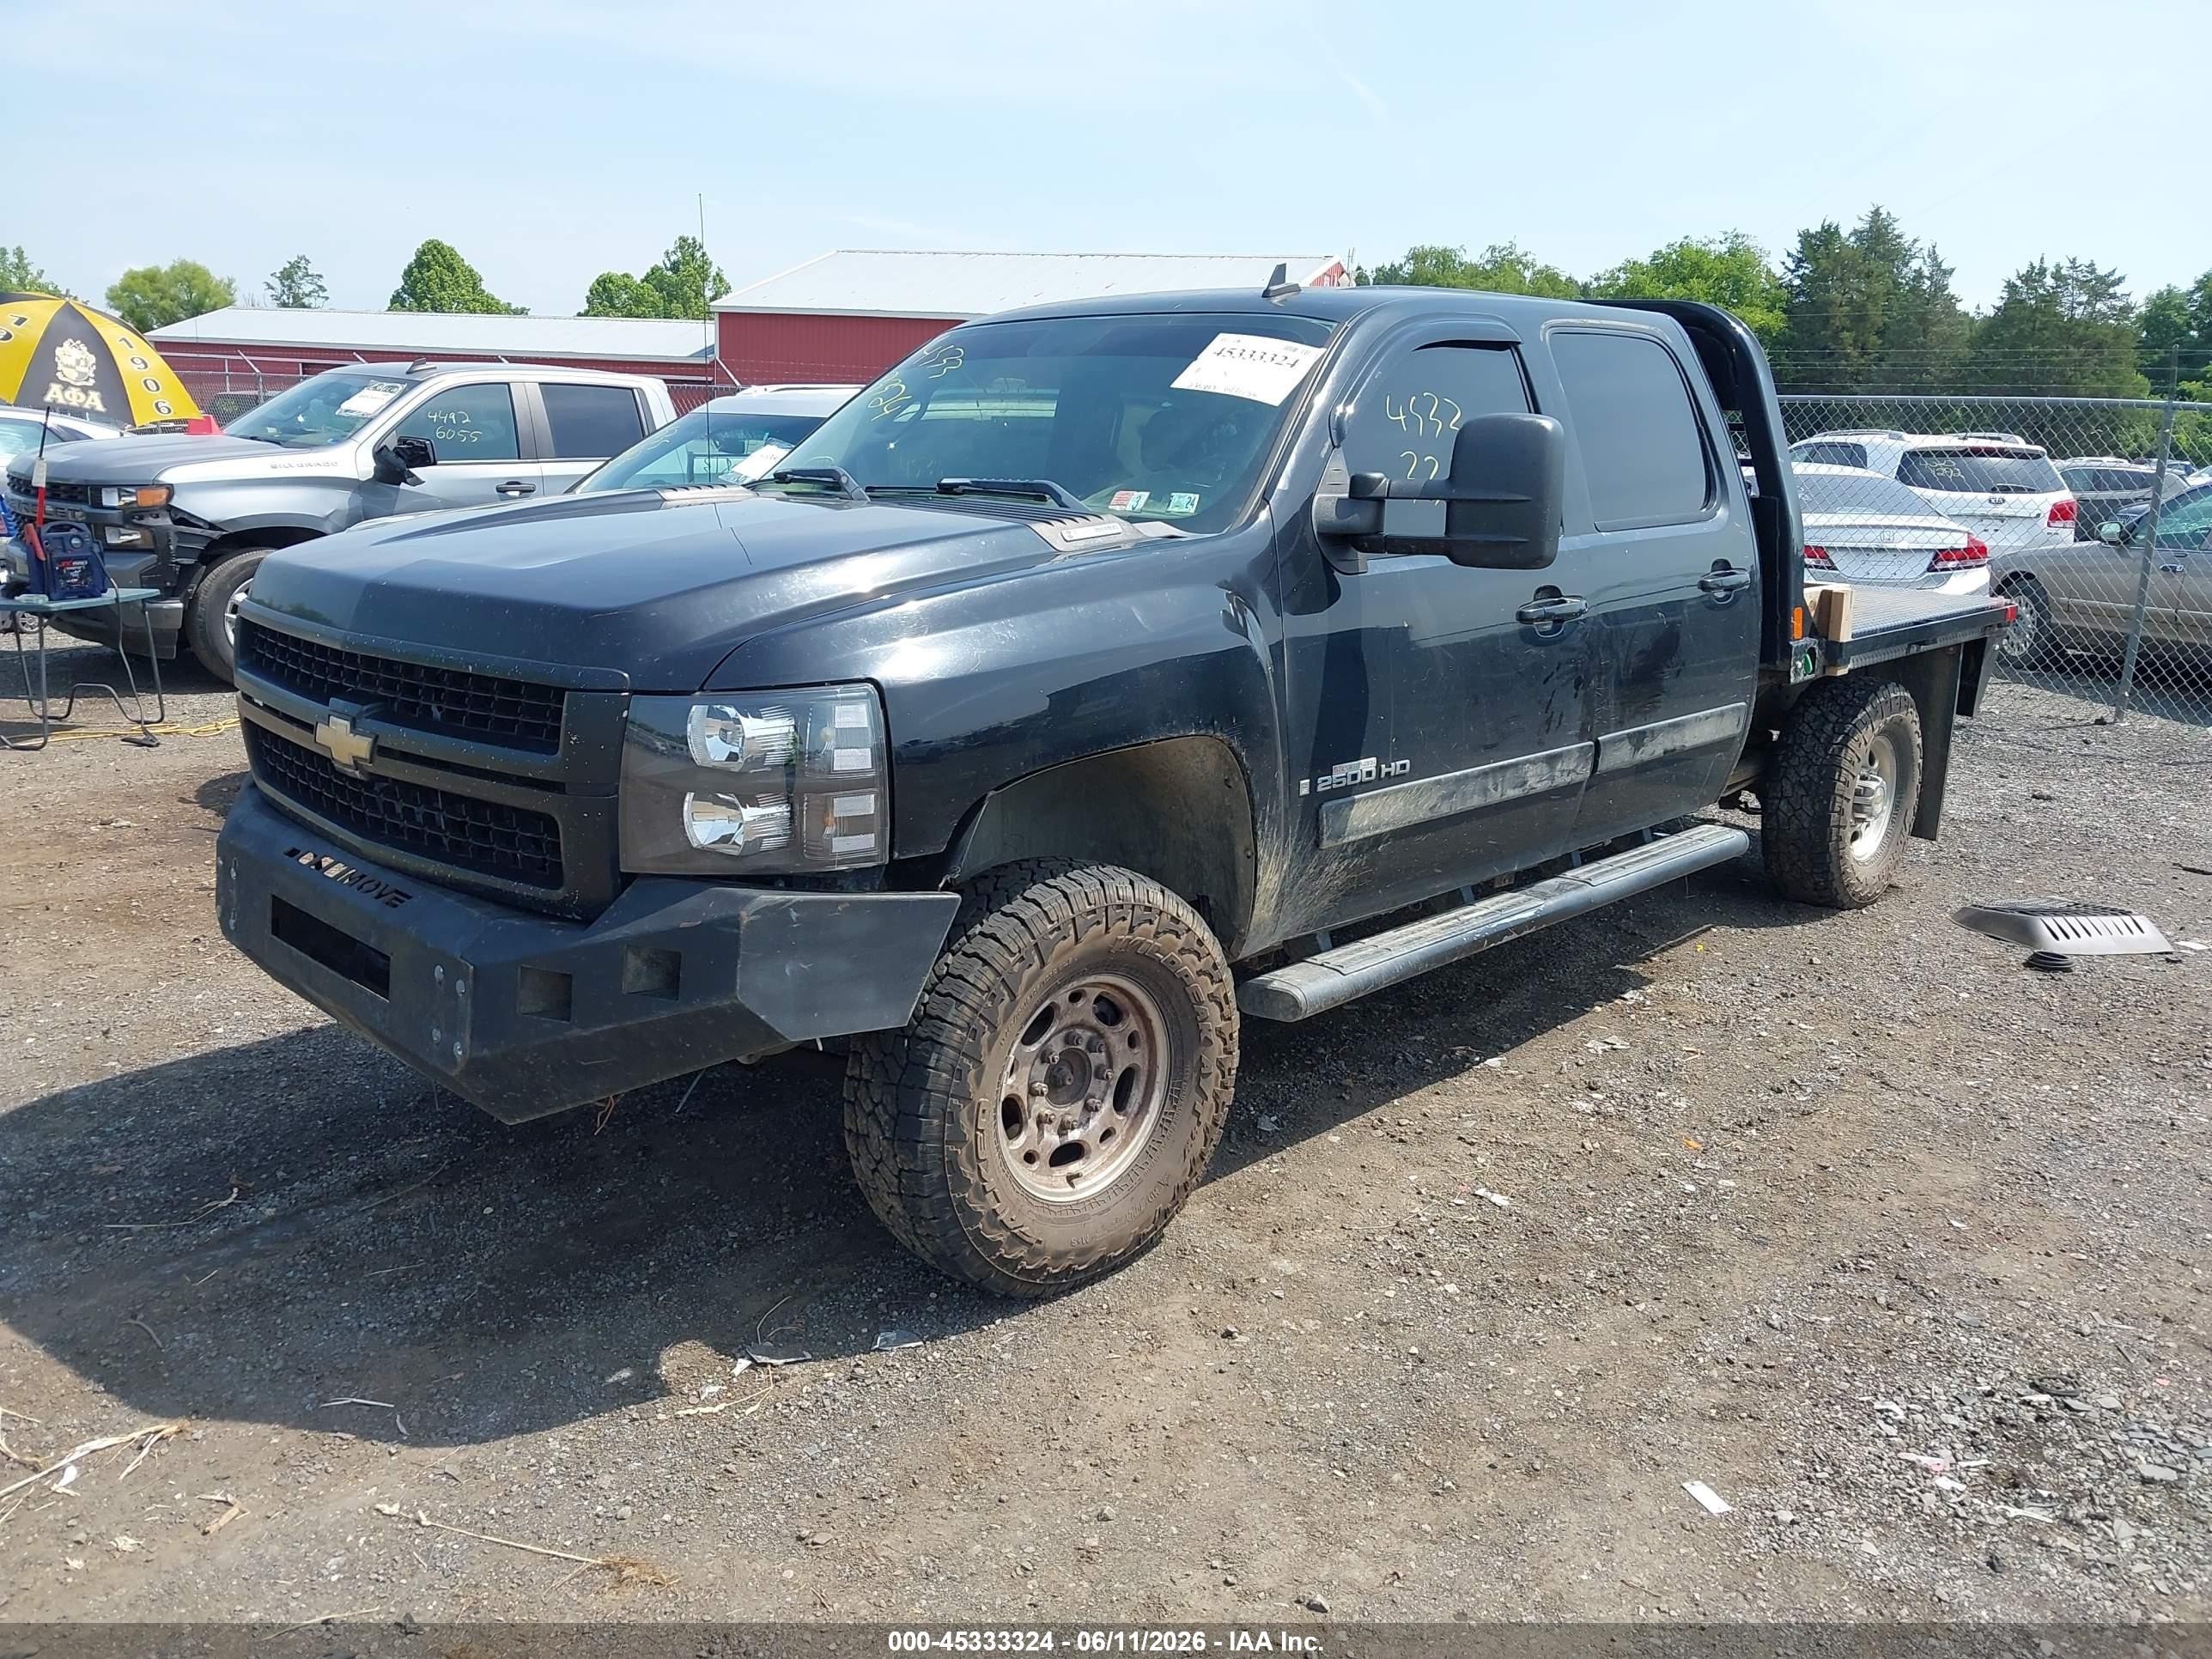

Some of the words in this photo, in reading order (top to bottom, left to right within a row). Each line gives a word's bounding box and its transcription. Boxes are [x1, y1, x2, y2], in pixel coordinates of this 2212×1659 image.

[1213, 347, 1300, 368] 45333324
[428, 410, 472, 424] 4492
[435, 425, 483, 442] 6055
[1316, 767, 1376, 792] 2500
[1380, 759, 1411, 779] HD
